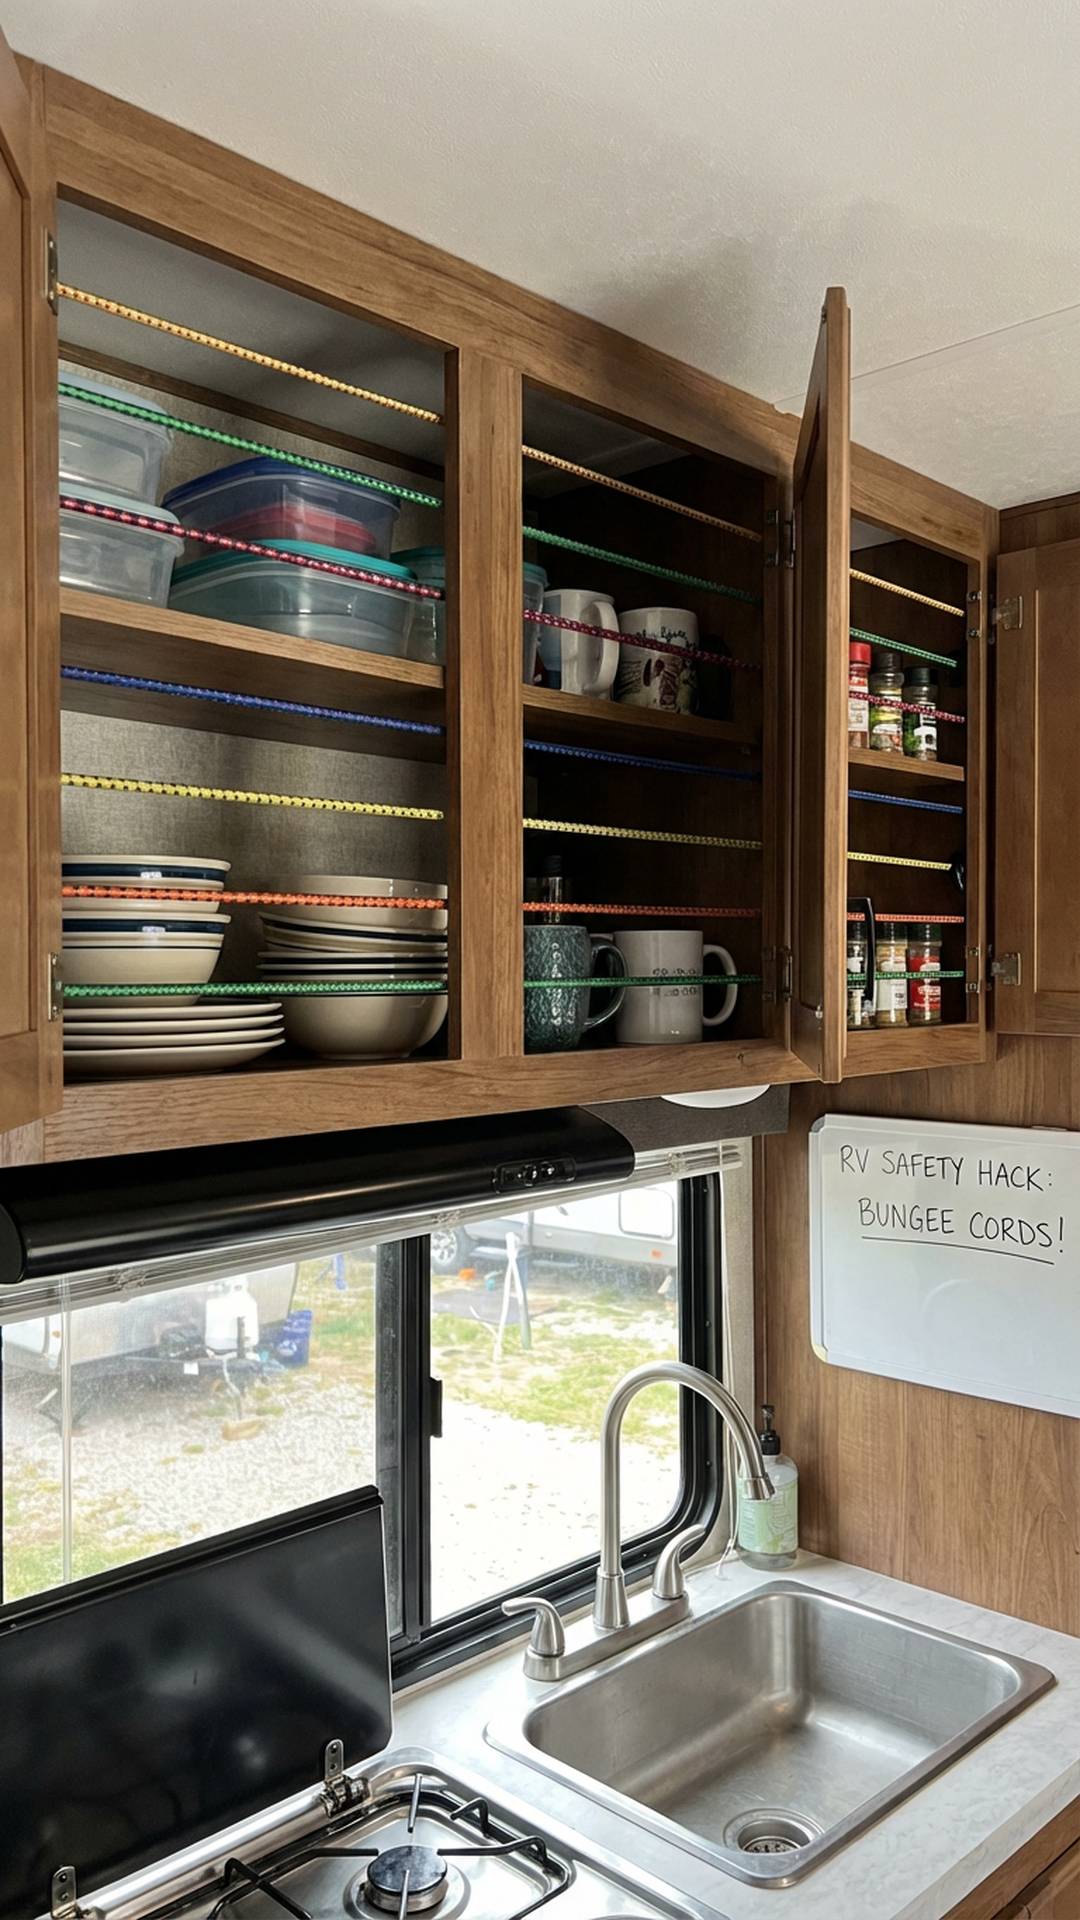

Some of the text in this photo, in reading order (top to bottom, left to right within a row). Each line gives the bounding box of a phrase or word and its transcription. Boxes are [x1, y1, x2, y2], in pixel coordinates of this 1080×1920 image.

[840, 1144, 1053, 1191] RV SAFETY HACK:
[858, 1197, 1064, 1253] BUNGEE CORDS!
